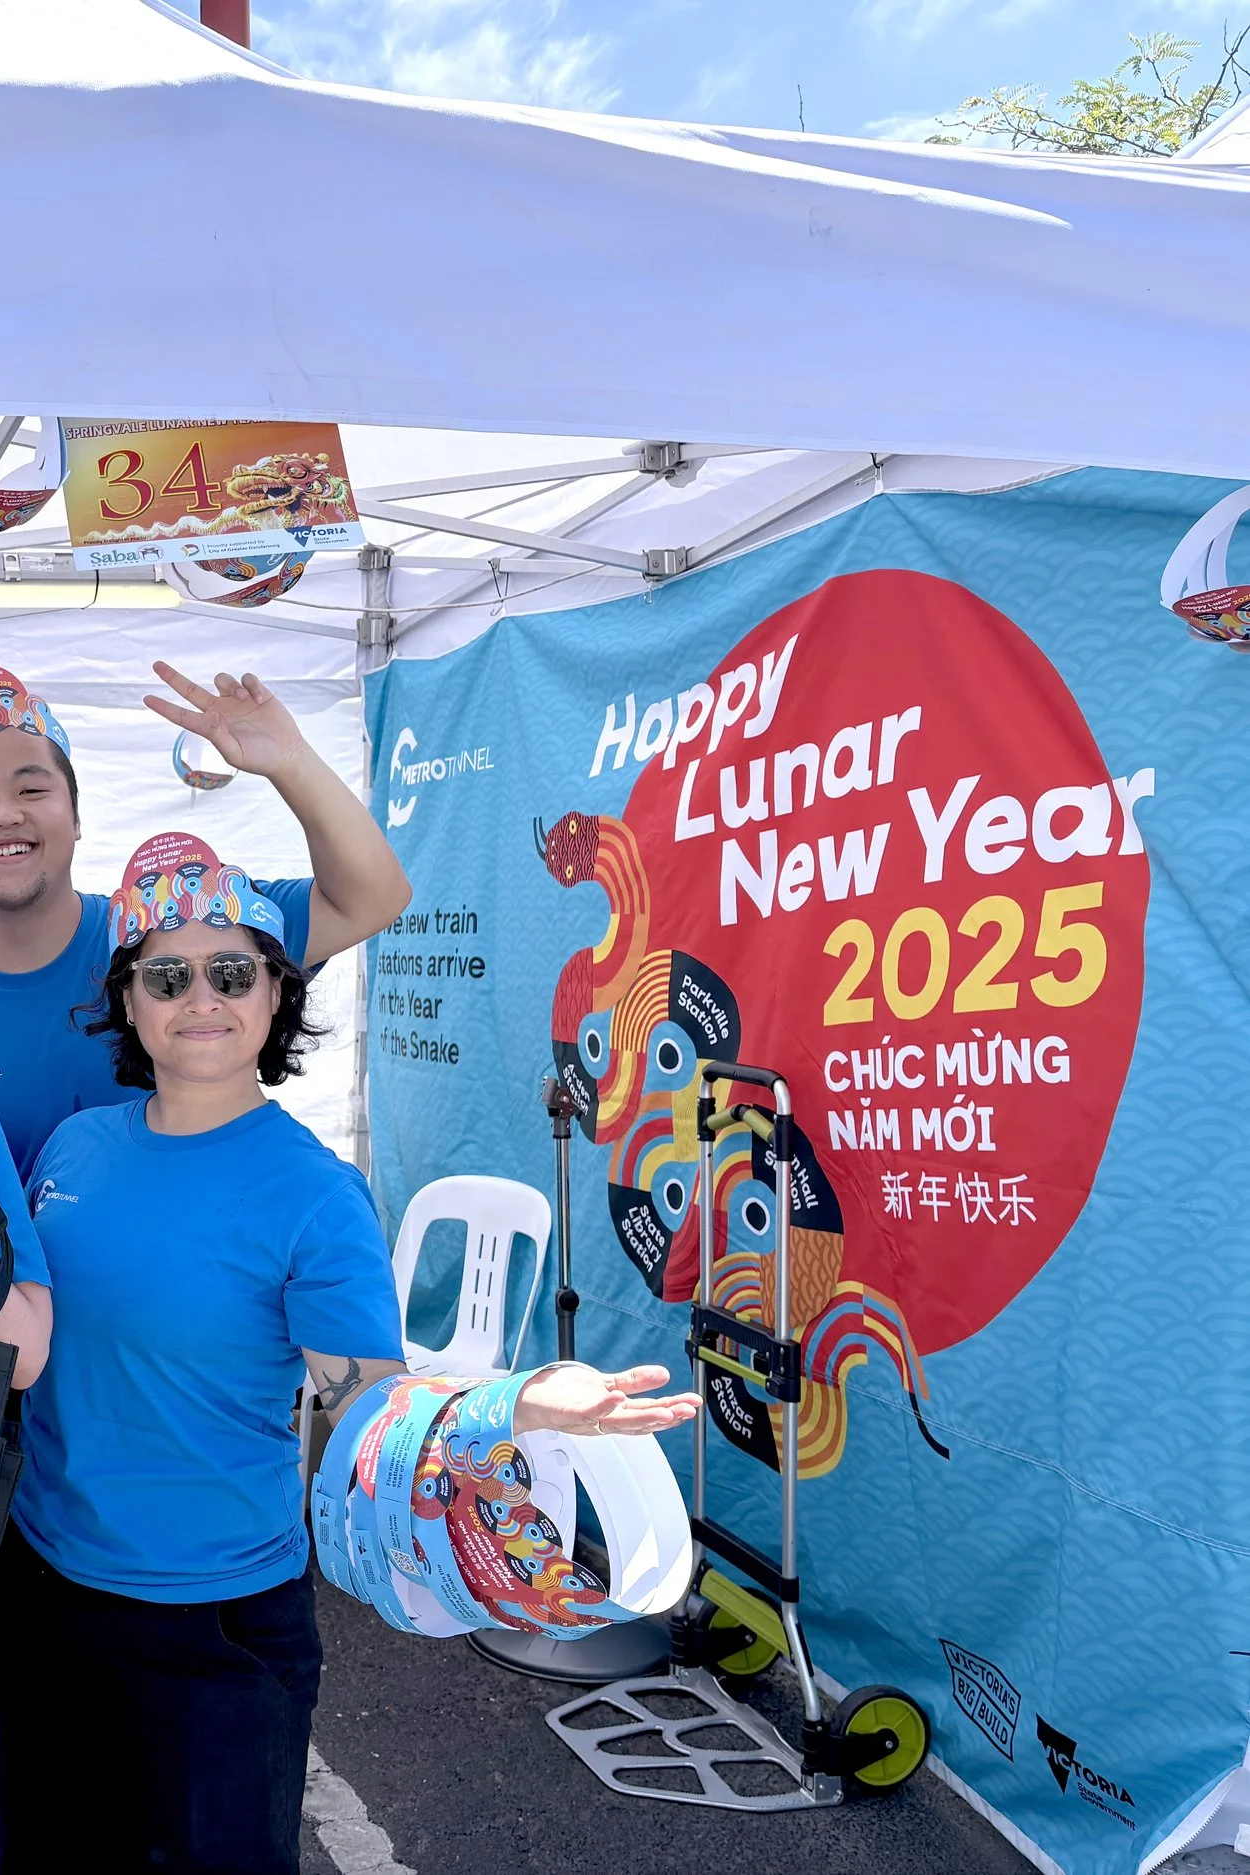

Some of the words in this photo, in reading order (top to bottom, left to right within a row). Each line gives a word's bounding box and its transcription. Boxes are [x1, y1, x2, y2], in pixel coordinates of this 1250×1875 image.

[65, 422, 147, 440] SPRINGVALE
[150, 420, 195, 432] LUNAR
[97, 441, 223, 520] 34
[292, 528, 348, 538] VICTORIA
[90, 550, 139, 564] Saba
[589, 632, 799, 779] Happy
[401, 745, 494, 787] METROTUNNEL
[675, 705, 923, 842] Lunar
[134, 854, 157, 868] Happy
[158, 849, 183, 860] Lunar
[142, 862, 158, 873] New
[159, 858, 178, 868] Year
[180, 854, 202, 862] 2025
[720, 822, 892, 927] New
[907, 766, 1155, 885] Year
[434, 904, 477, 934] train
[378, 948, 423, 976] stations
[427, 947, 485, 979] arrive
[822, 881, 1109, 1027] 2025
[378, 986, 386, 1015] in
[388, 991, 405, 1017] the
[407, 990, 442, 1021] Year
[676, 991, 719, 1047] Station
[681, 973, 731, 1042] Parkville
[380, 1026, 388, 1055] of
[391, 1030, 408, 1058] the
[410, 1032, 460, 1065] Snake
[823, 1035, 926, 1092] CHÚC
[934, 1028, 1072, 1089] MỪNG
[560, 1067, 591, 1118] Station
[565, 1062, 592, 1102] Arden
[828, 1104, 902, 1152] NĂM
[912, 1094, 996, 1152] MỚI
[764, 1150, 802, 1211] Stion
[798, 1168, 819, 1210] Hall
[881, 1170, 1038, 1228] 新年快乐
[620, 1218, 654, 1274] Station
[627, 1205, 662, 1265] Library
[638, 1204, 666, 1249] State
[711, 1377, 753, 1440] Station
[719, 1374, 755, 1425] Anzac
[467, 1505, 484, 1533] 2025
[472, 1531, 491, 1559] Lunar
[482, 1535, 497, 1558] Year
[491, 1561, 515, 1591] Happy
[498, 1558, 514, 1579] New
[949, 1648, 1015, 1716] VICTORIA'S
[957, 1676, 976, 1708] BIG
[978, 1702, 1008, 1746] BUILD
[1046, 1745, 1136, 1808] VICTORIA
[1077, 1781, 1104, 1803] State
[1080, 1791, 1136, 1831] Government
